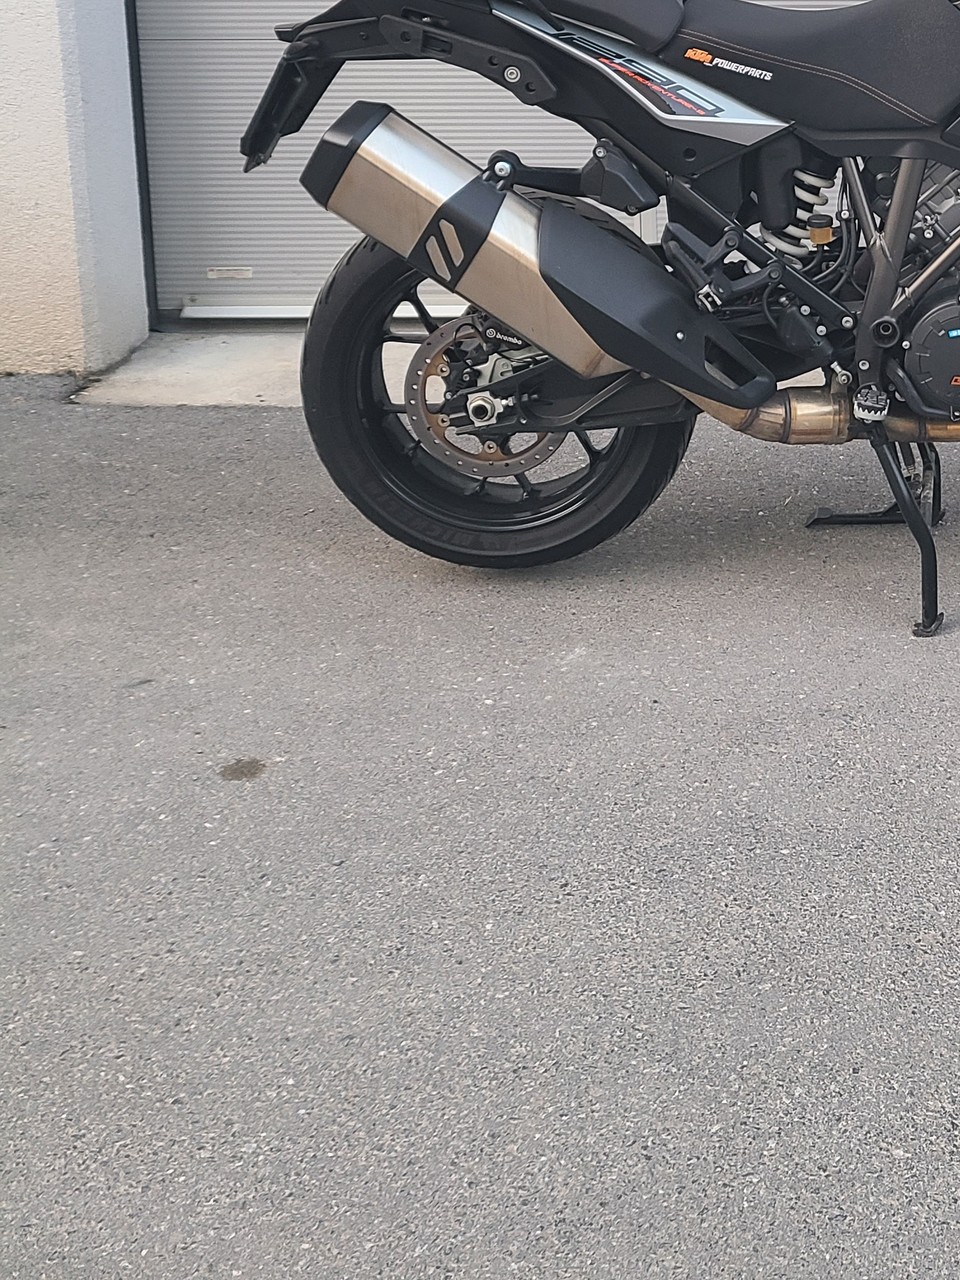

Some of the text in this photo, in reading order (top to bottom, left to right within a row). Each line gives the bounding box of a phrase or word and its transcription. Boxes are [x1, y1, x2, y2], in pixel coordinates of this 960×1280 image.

[684, 47, 773, 80] KTM POWERPARTS
[495, 332, 522, 344] brembo
